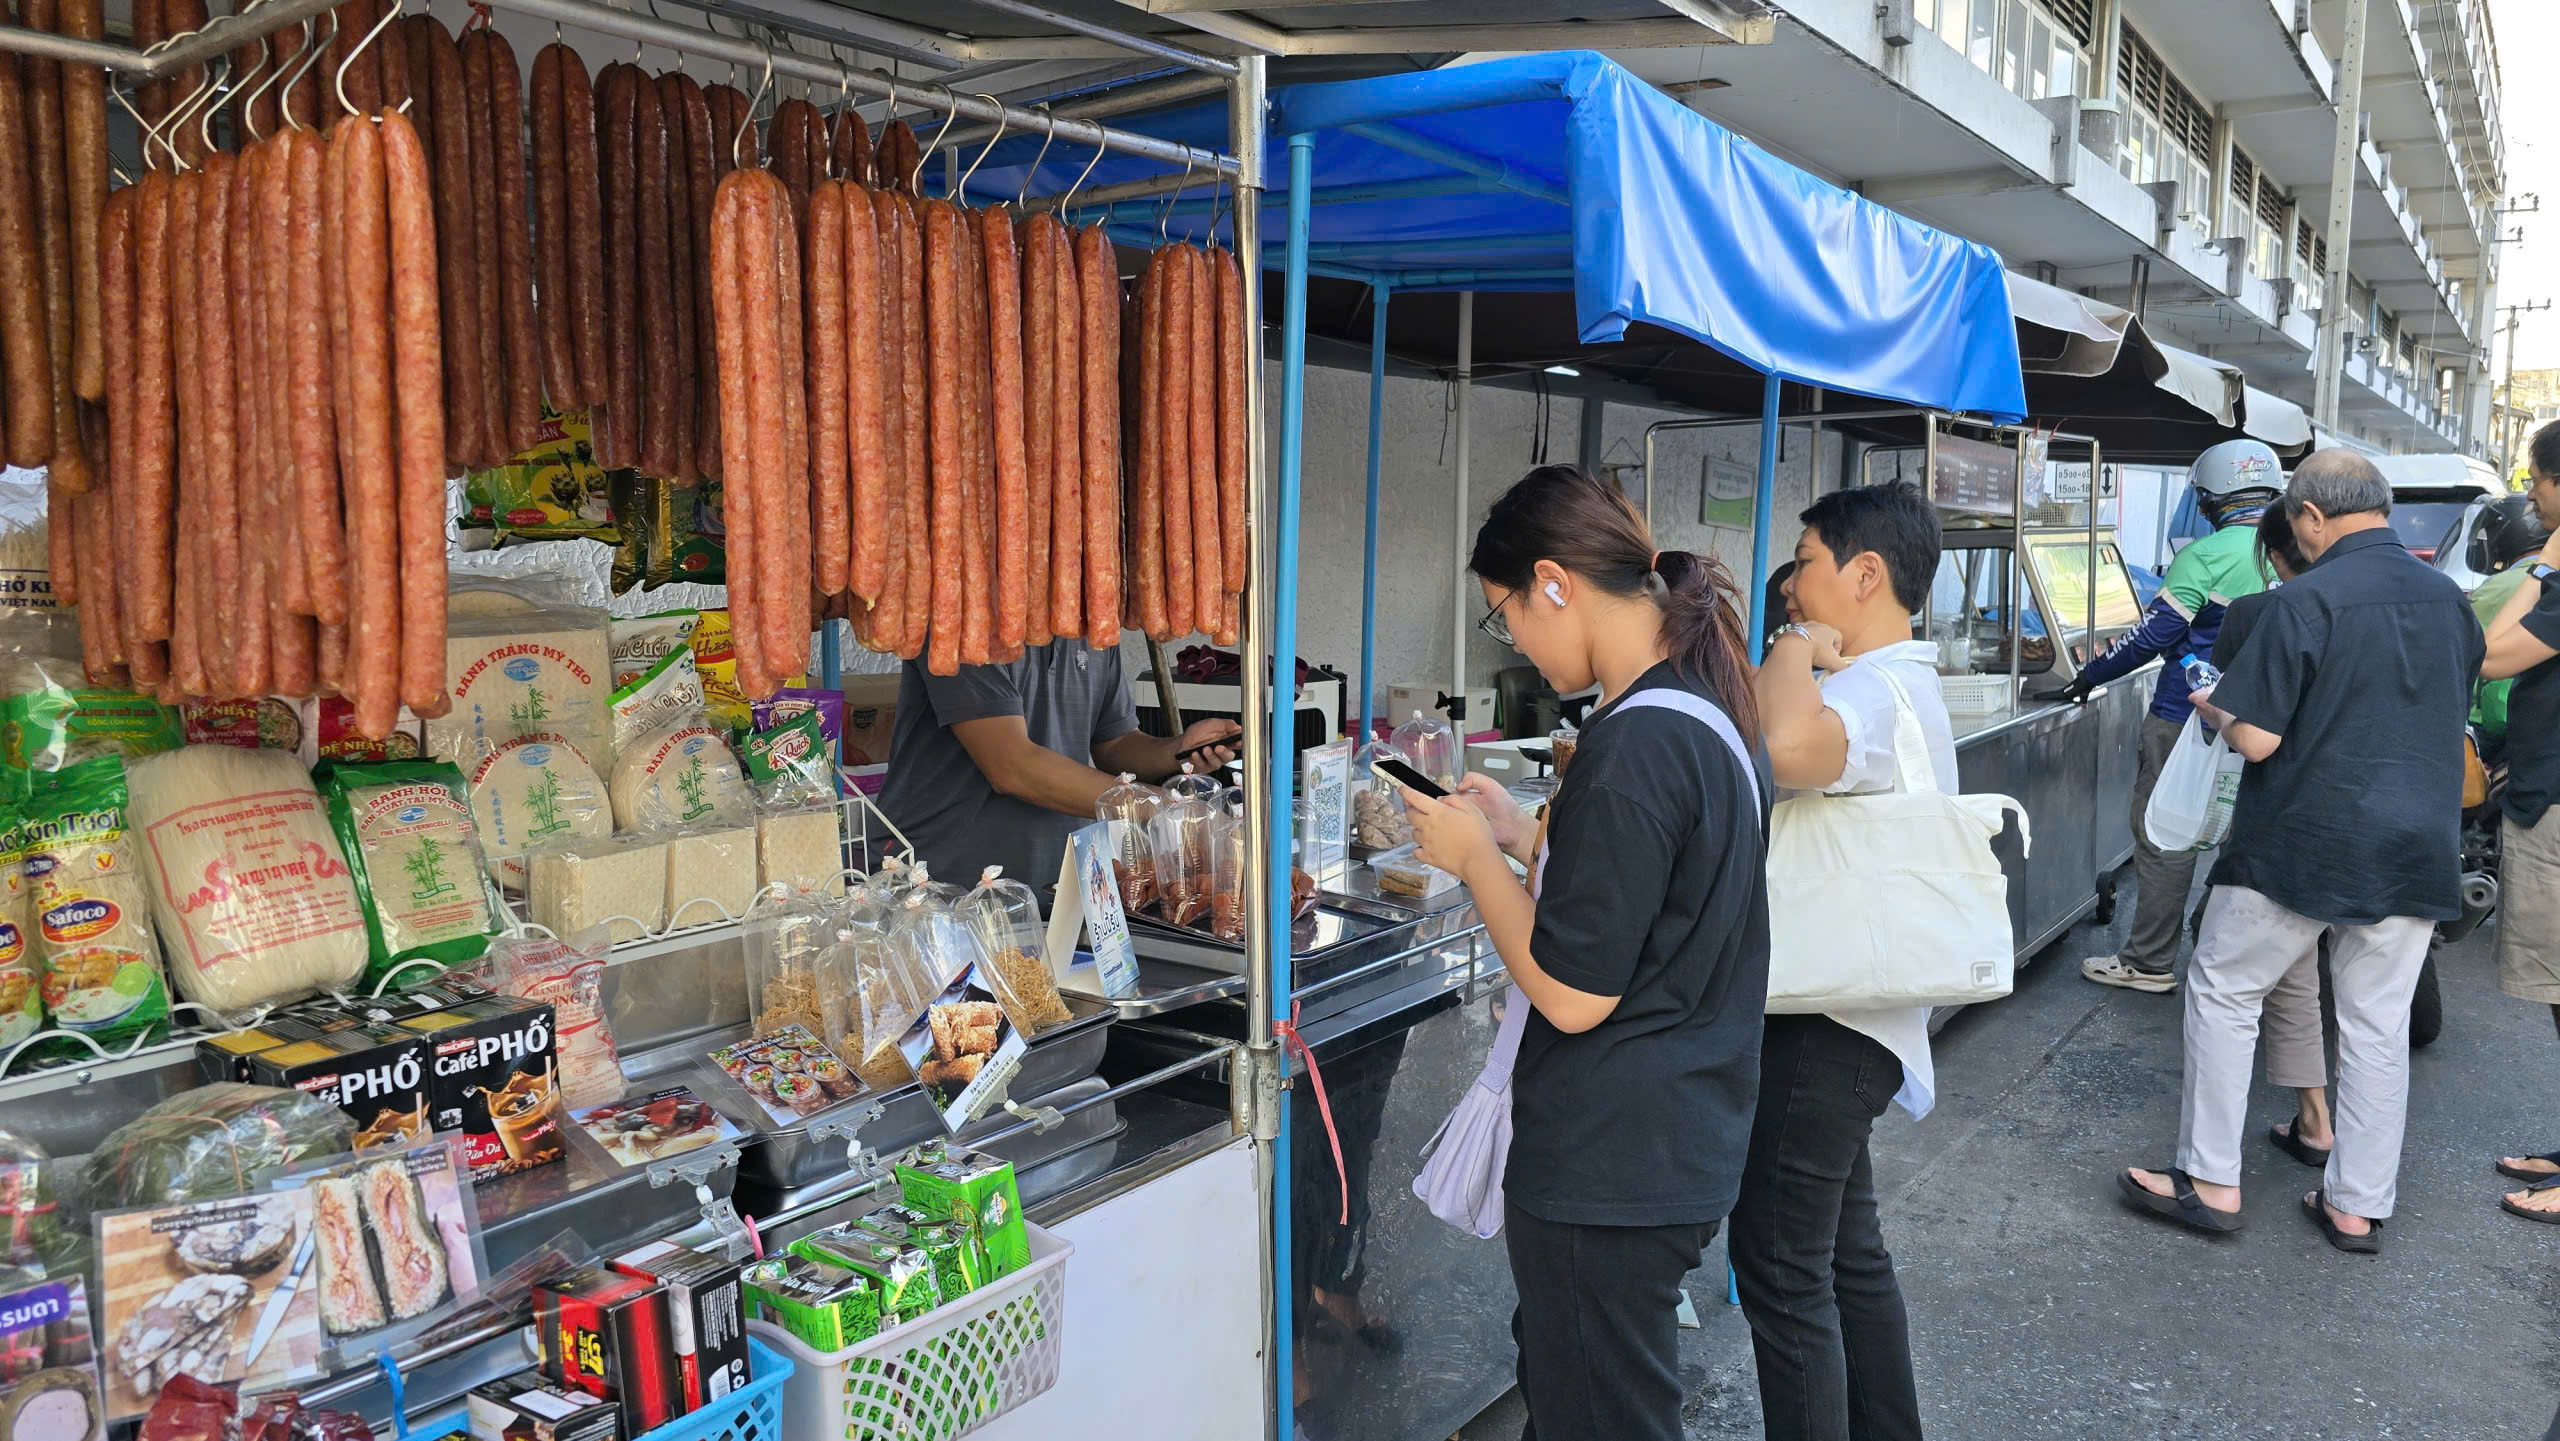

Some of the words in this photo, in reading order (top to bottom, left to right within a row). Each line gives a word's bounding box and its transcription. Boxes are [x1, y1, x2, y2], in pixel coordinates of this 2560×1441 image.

[0, 576, 26, 593] HỞ
[455, 658, 488, 699] BÁNH
[487, 643, 540, 663] TRÁNG
[565, 658, 592, 685] THO
[472, 749, 502, 786] BÁNH
[645, 742, 672, 775] BÁNH
[669, 727, 705, 745] TRÁNG
[368, 787, 415, 809] BÁNH
[446, 800, 468, 814] THO
[46, 903, 107, 927] Safoco
[434, 1048, 479, 1077] Café
[477, 1013, 549, 1067] PHỐ
[340, 1047, 421, 1106] PHỐ
[0, 1298, 60, 1328] รมดา
